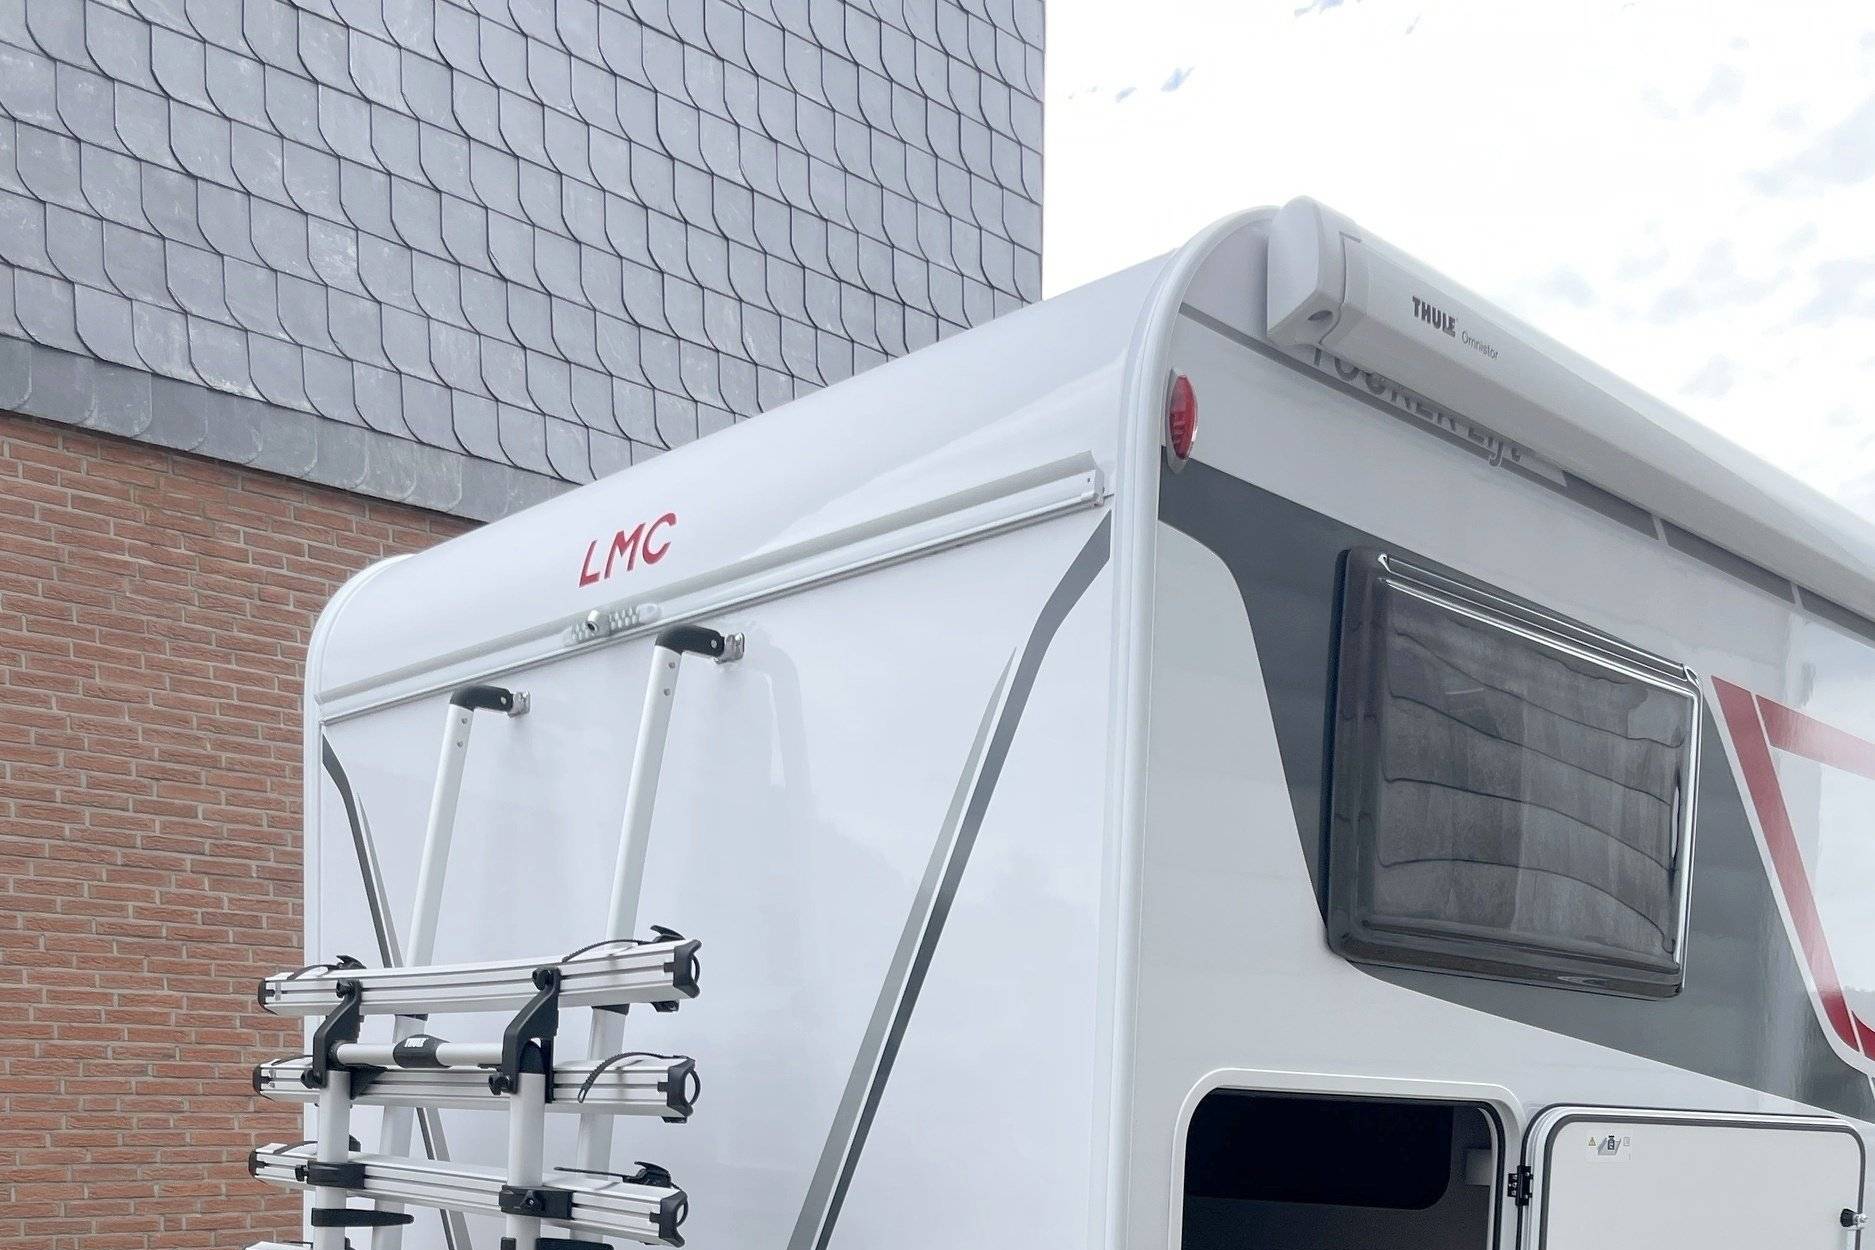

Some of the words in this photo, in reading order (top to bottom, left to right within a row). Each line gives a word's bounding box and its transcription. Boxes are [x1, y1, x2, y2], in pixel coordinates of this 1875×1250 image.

[1412, 296, 1456, 338] THULE
[1461, 330, 1499, 359] Omnistor
[579, 512, 677, 588] LMC
